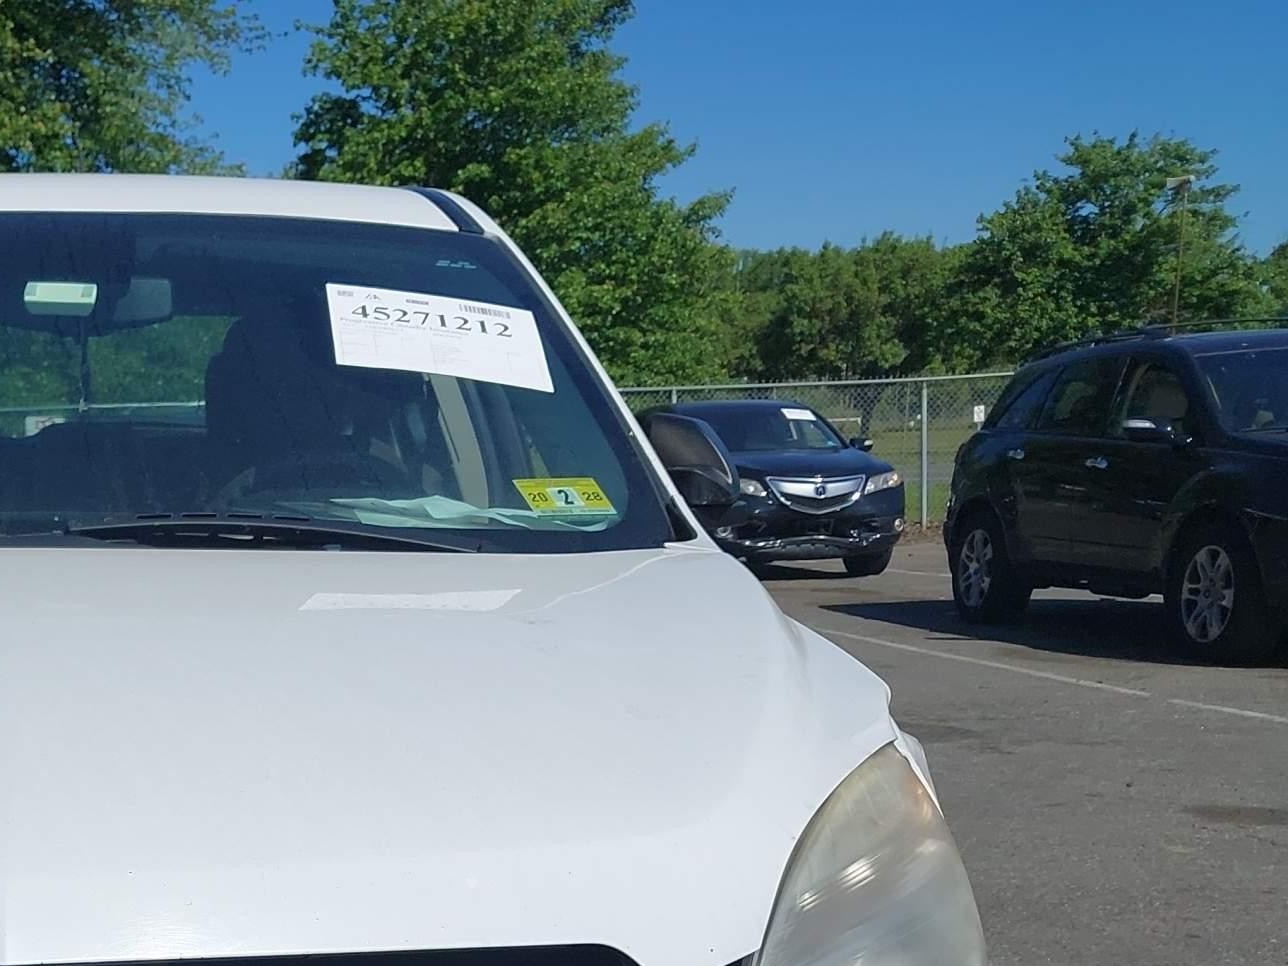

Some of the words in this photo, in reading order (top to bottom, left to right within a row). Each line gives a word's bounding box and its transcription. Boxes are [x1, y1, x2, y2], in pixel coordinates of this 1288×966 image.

[351, 303, 513, 338] 45271212
[527, 492, 549, 503] 20
[557, 489, 575, 505] 2
[581, 491, 603, 502] 28
